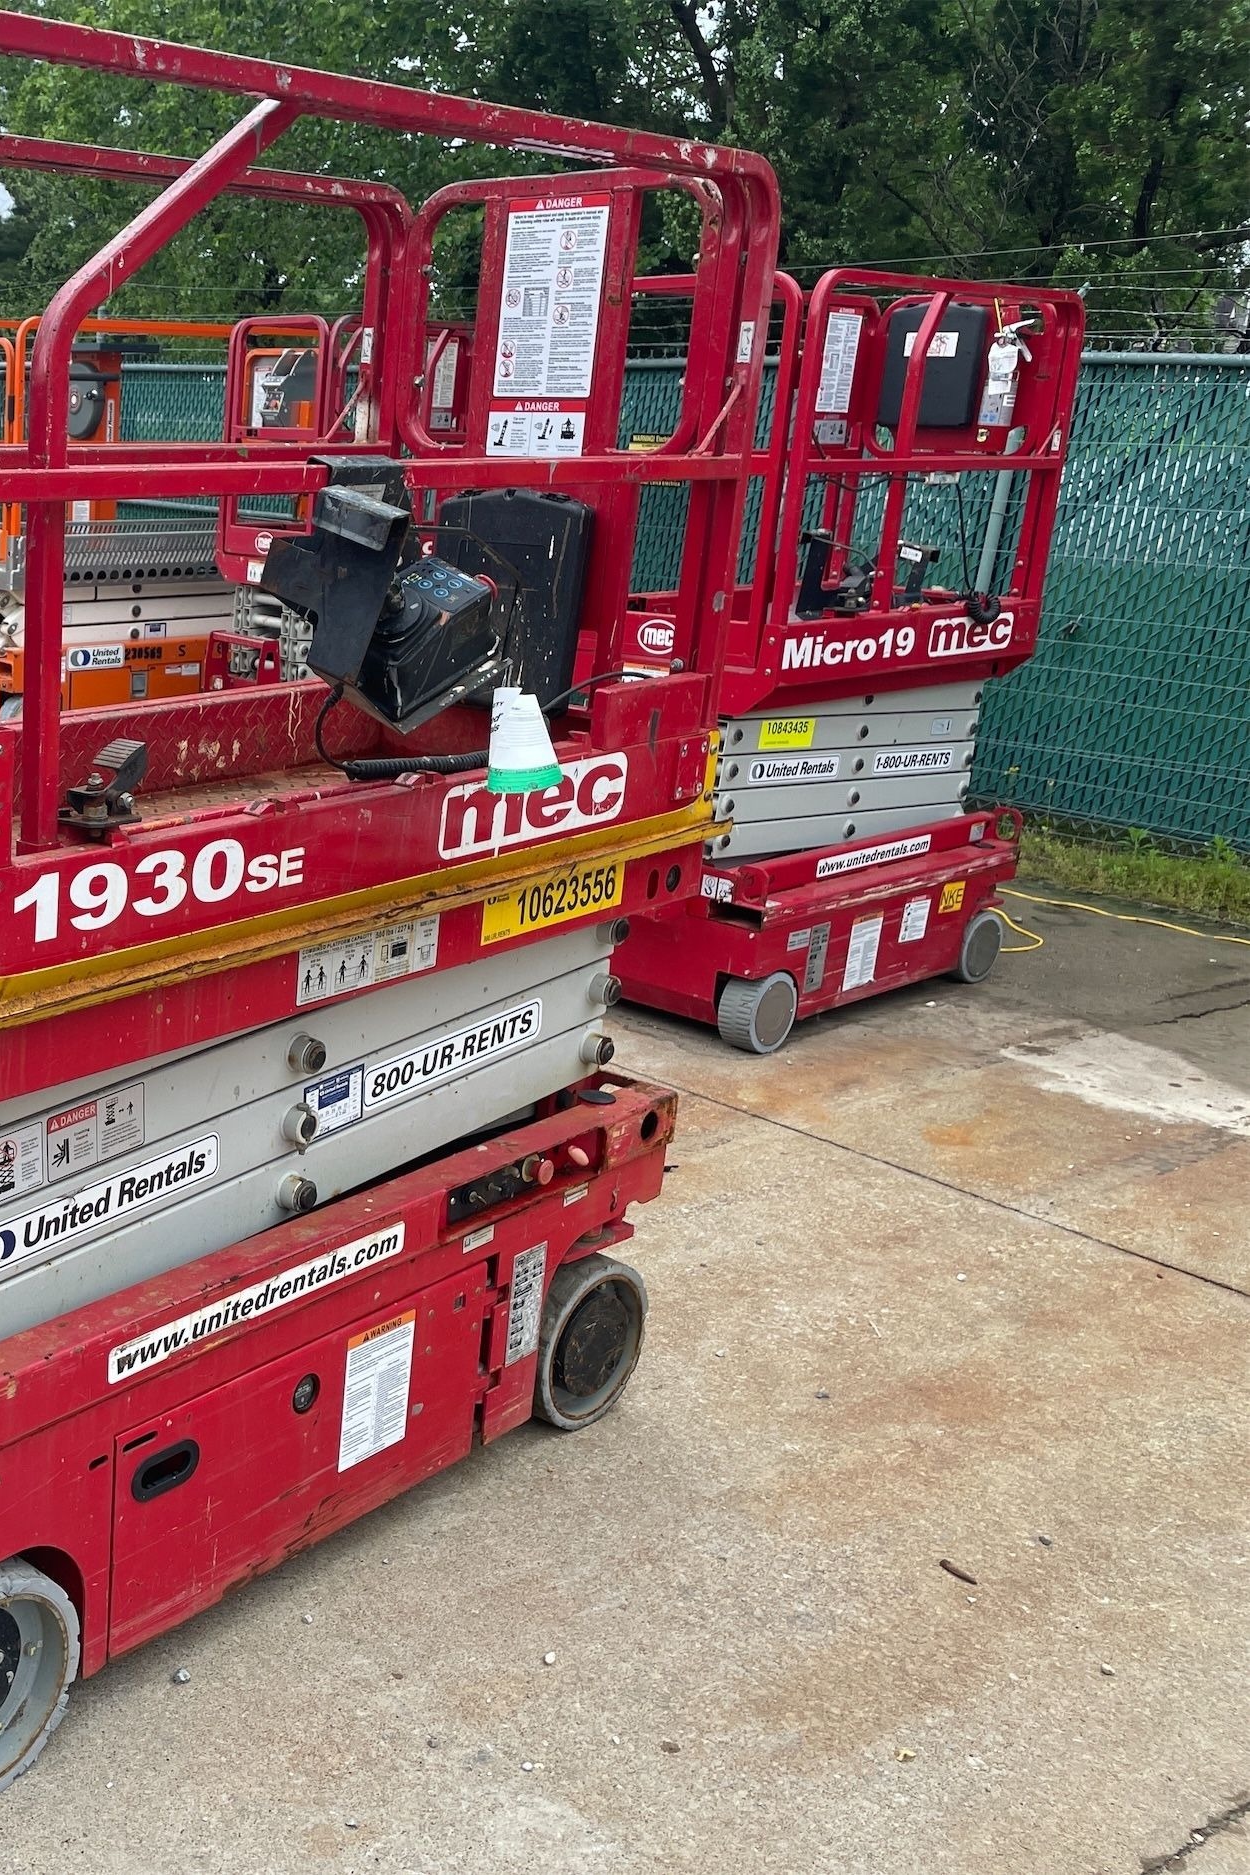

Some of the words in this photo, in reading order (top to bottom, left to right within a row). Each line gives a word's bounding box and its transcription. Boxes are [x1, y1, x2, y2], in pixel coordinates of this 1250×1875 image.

[545, 197, 582, 209] DANGER
[524, 402, 560, 411] DANGER
[643, 628, 674, 647] mec
[932, 617, 1010, 652] mec
[92, 647, 119, 657] United
[782, 627, 915, 670] Micro19
[91, 656, 121, 666] Rentals
[767, 721, 808, 735] 10843435
[766, 762, 798, 778] United
[800, 760, 834, 775] Rentals
[876, 752, 950, 769] 1-800-UR-RENTS
[443, 764, 623, 851] mec
[818, 839, 929, 875] www.unitedrentals.com
[517, 865, 617, 925] 10623556
[397, 925, 407, 933] 227
[327, 938, 351, 950] PLATFORM
[351, 932, 372, 944] CAPACITY
[372, 1009, 533, 1098] 800-UR-RENTS
[60, 1105, 96, 1127] DANGER
[23, 1187, 111, 1247] United
[117, 1151, 206, 1207] Rentals
[116, 1232, 399, 1374] www.unitedrentals.com
[370, 1317, 402, 1338] WARNING
